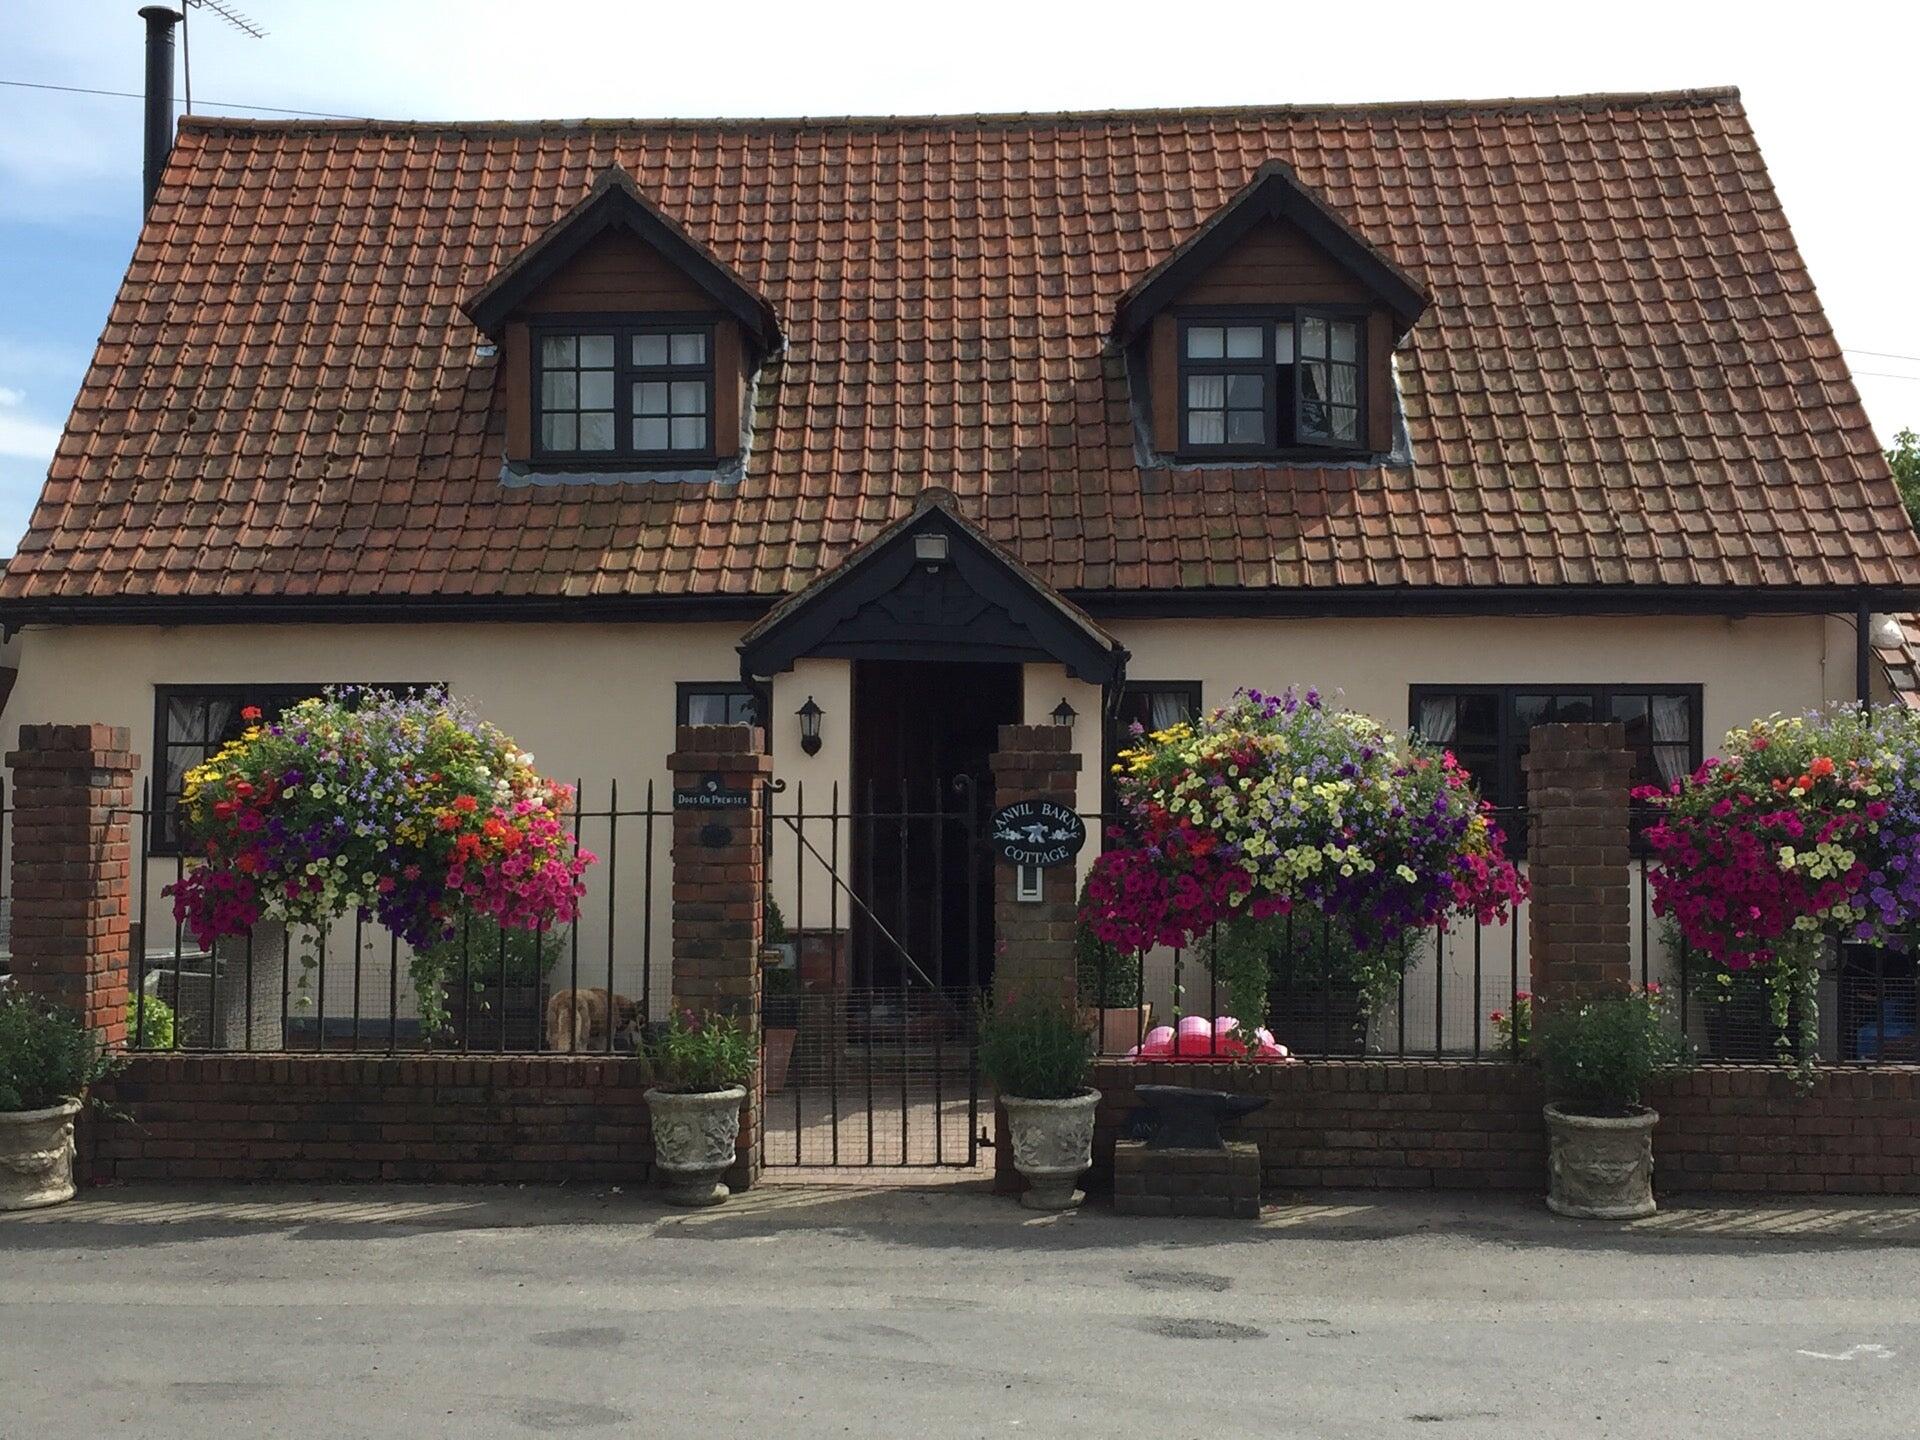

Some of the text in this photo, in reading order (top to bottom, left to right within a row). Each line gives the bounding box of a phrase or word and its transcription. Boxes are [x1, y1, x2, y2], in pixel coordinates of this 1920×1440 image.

[995, 803, 1079, 830] ANVIL BARN
[1004, 845, 1069, 863] COTTAGE
